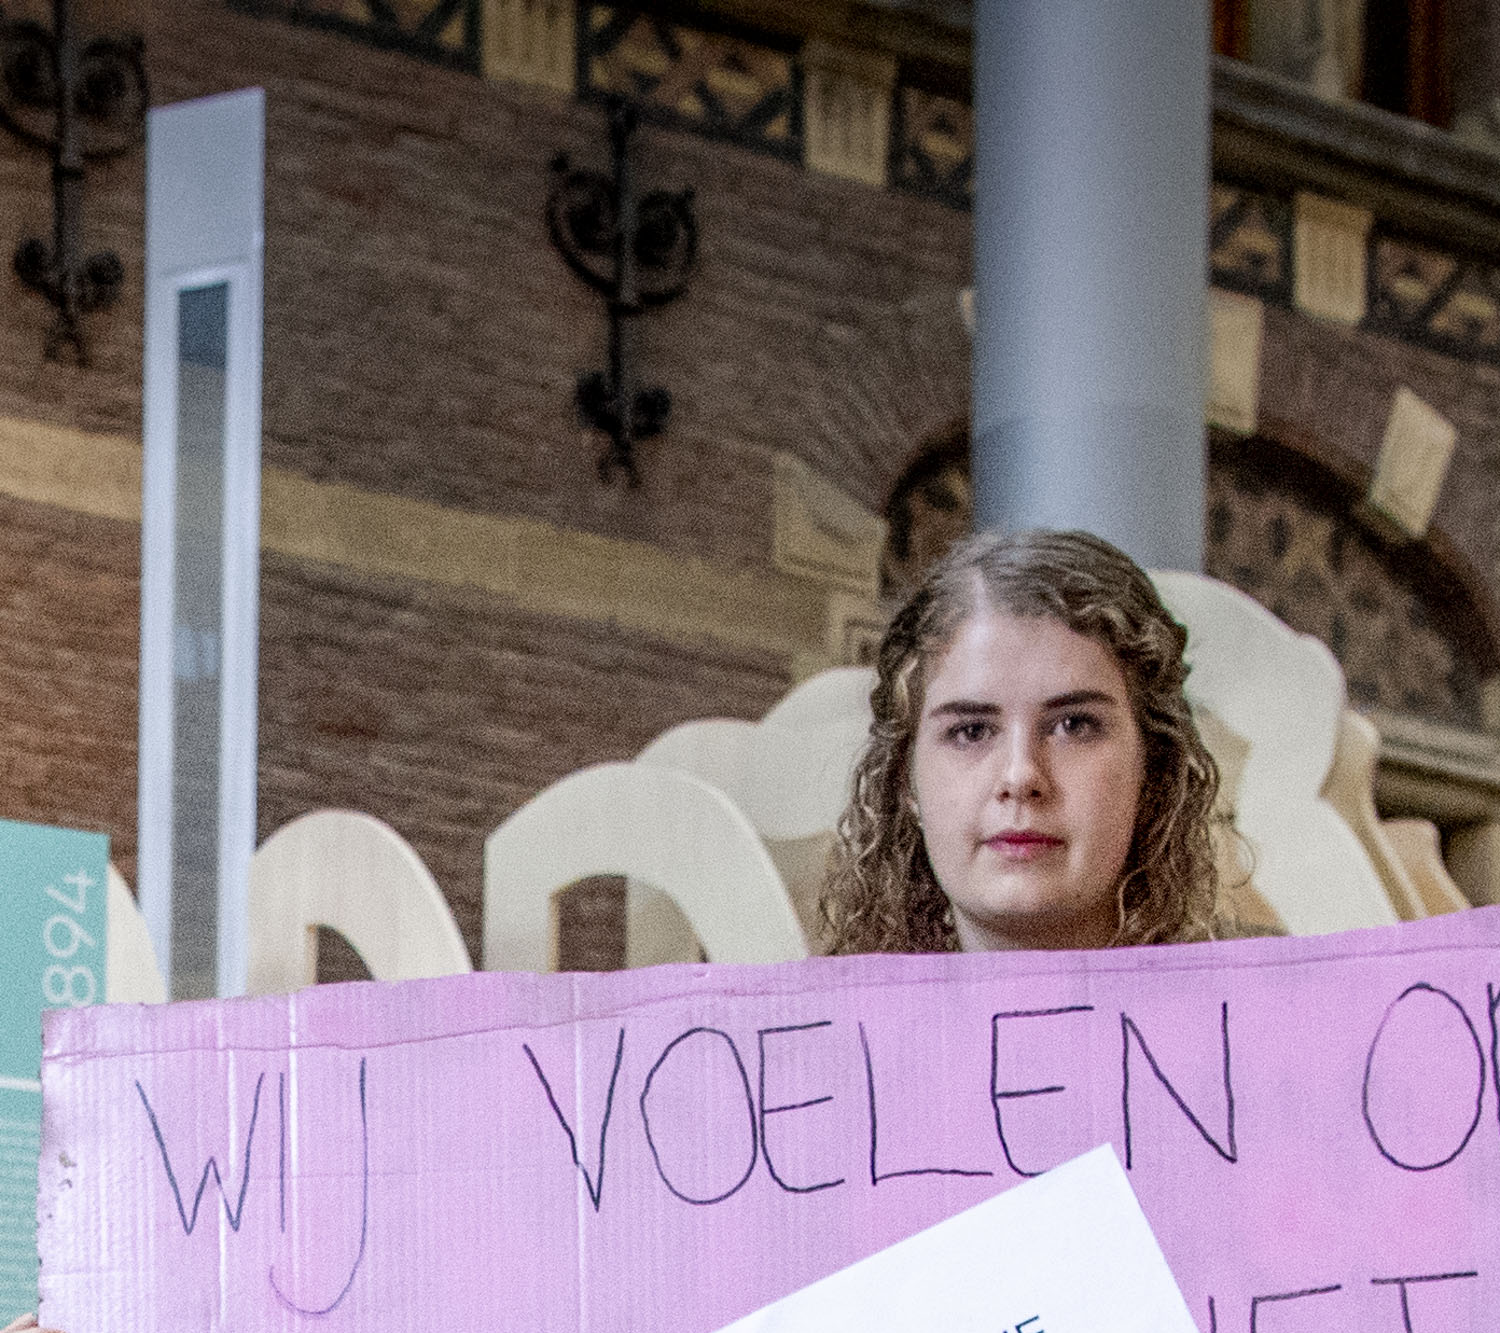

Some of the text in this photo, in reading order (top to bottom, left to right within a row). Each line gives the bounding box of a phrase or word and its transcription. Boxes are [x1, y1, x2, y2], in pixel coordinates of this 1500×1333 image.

[42, 868, 97, 1008] 894
[135, 1054, 368, 1315] WIJ
[521, 1001, 1237, 1213] VOELEN
